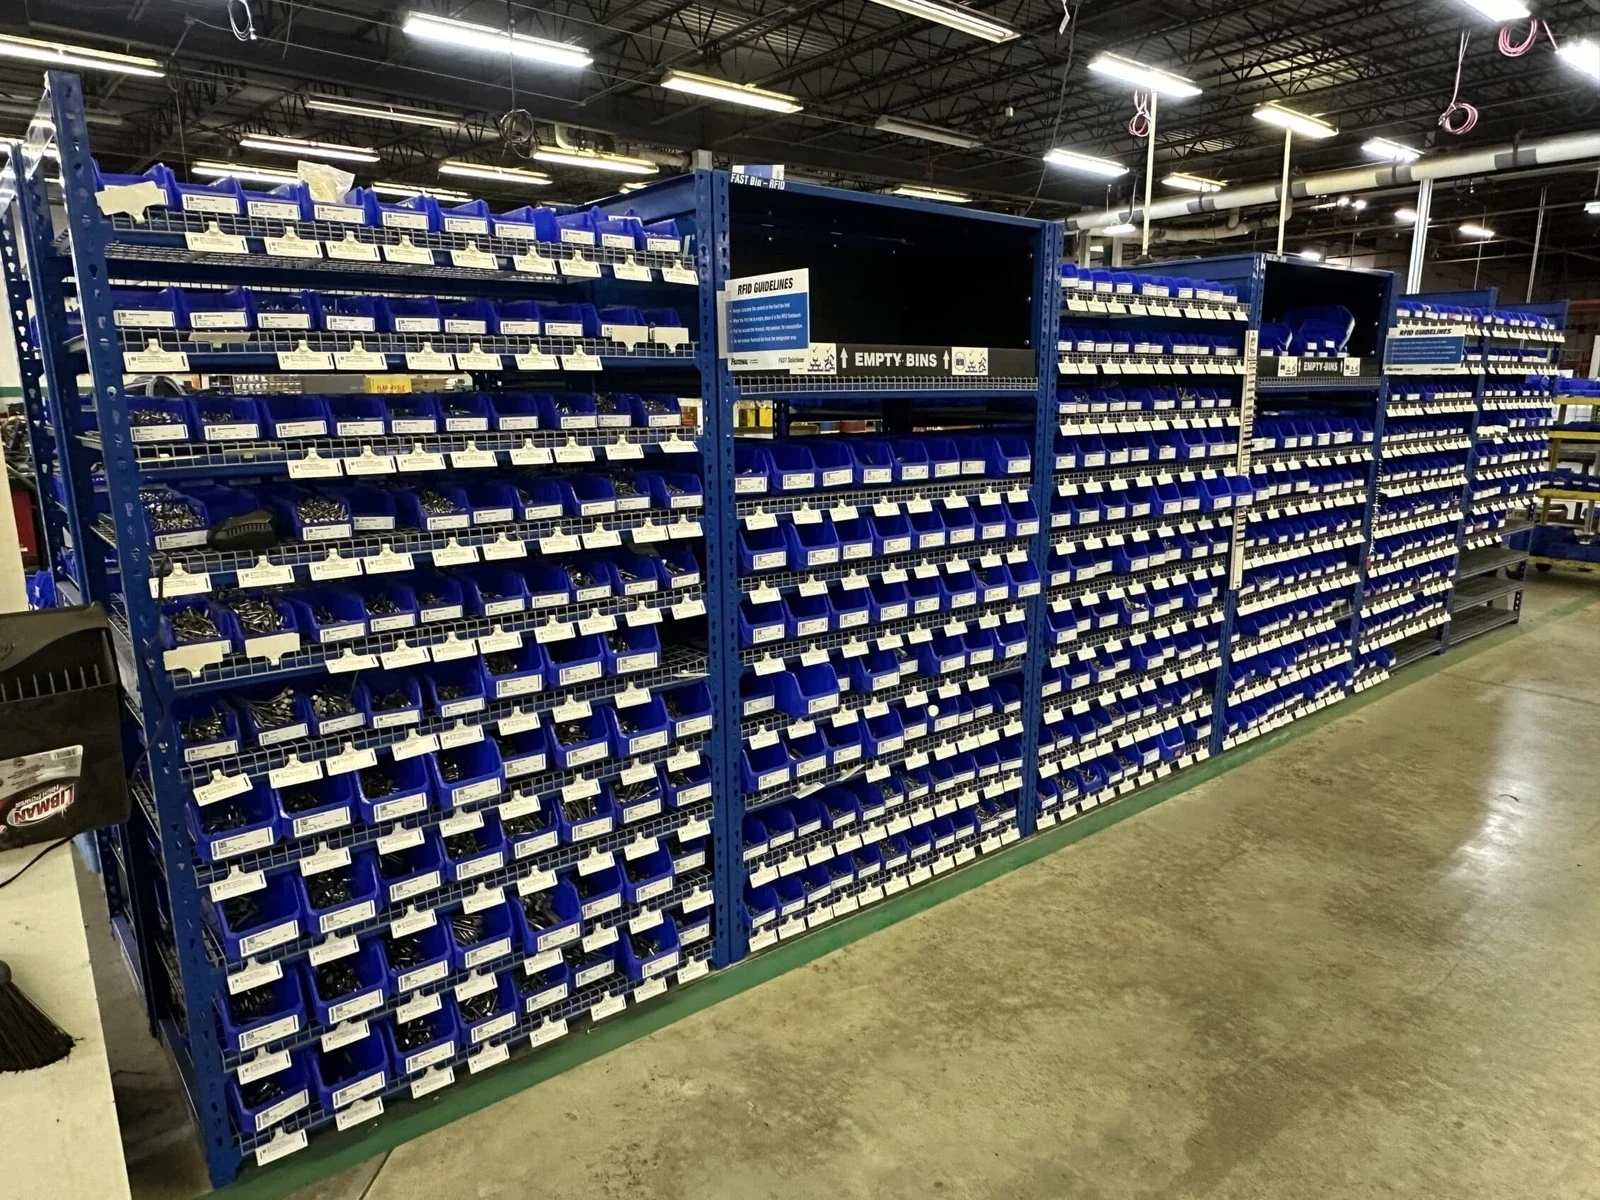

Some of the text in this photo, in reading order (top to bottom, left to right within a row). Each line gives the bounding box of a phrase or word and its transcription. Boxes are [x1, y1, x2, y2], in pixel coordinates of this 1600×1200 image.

[731, 173, 749, 184] FAST
[769, 179, 785, 190] RFID
[737, 278, 793, 295] RFID GUIDELINES
[1415, 328, 1452, 336] GUIDELINES
[855, 352, 937, 367] EMPTY BINS
[14, 783, 75, 825] LIBMAN
